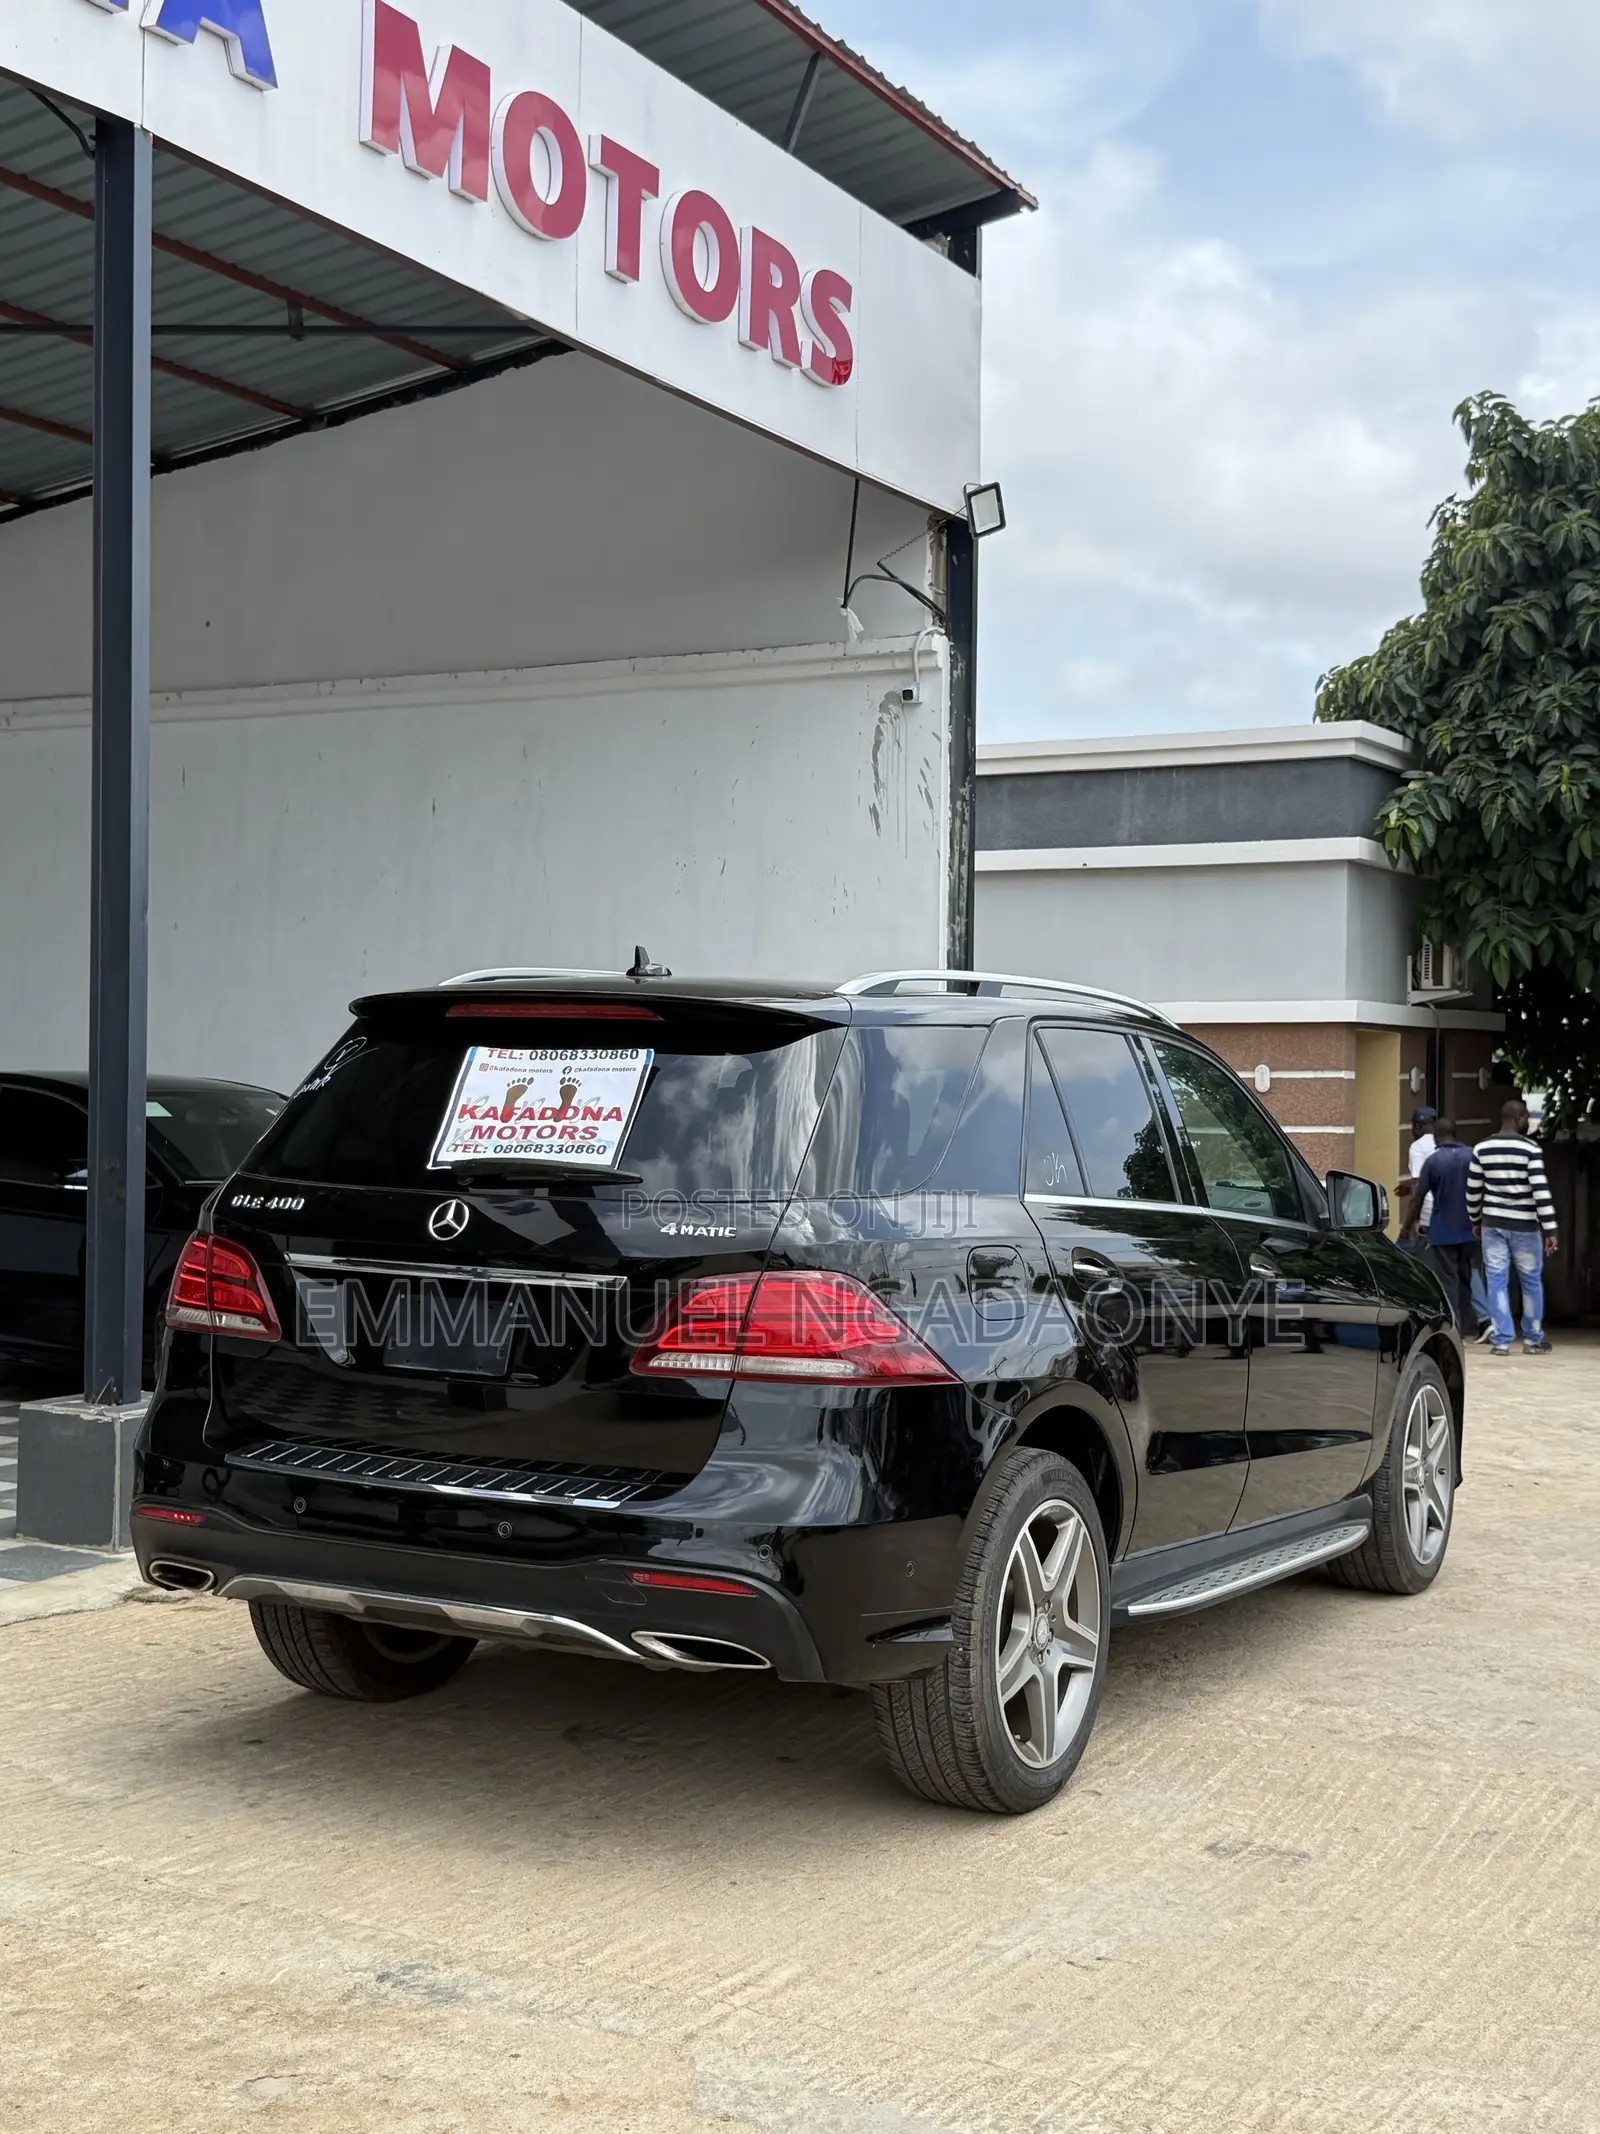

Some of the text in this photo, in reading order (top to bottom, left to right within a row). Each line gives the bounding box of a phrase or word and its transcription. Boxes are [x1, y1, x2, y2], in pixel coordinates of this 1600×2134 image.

[360, 0, 854, 387] MOTORS
[487, 1048, 640, 1061] TEL: 08068330860
[457, 1104, 623, 1122] KAFADONA
[470, 1125, 599, 1140] MOTORS
[453, 1143, 608, 1155] TEL: 08068330860
[231, 1195, 306, 1211] GLE 400
[659, 1221, 738, 1239] 4MATIC
